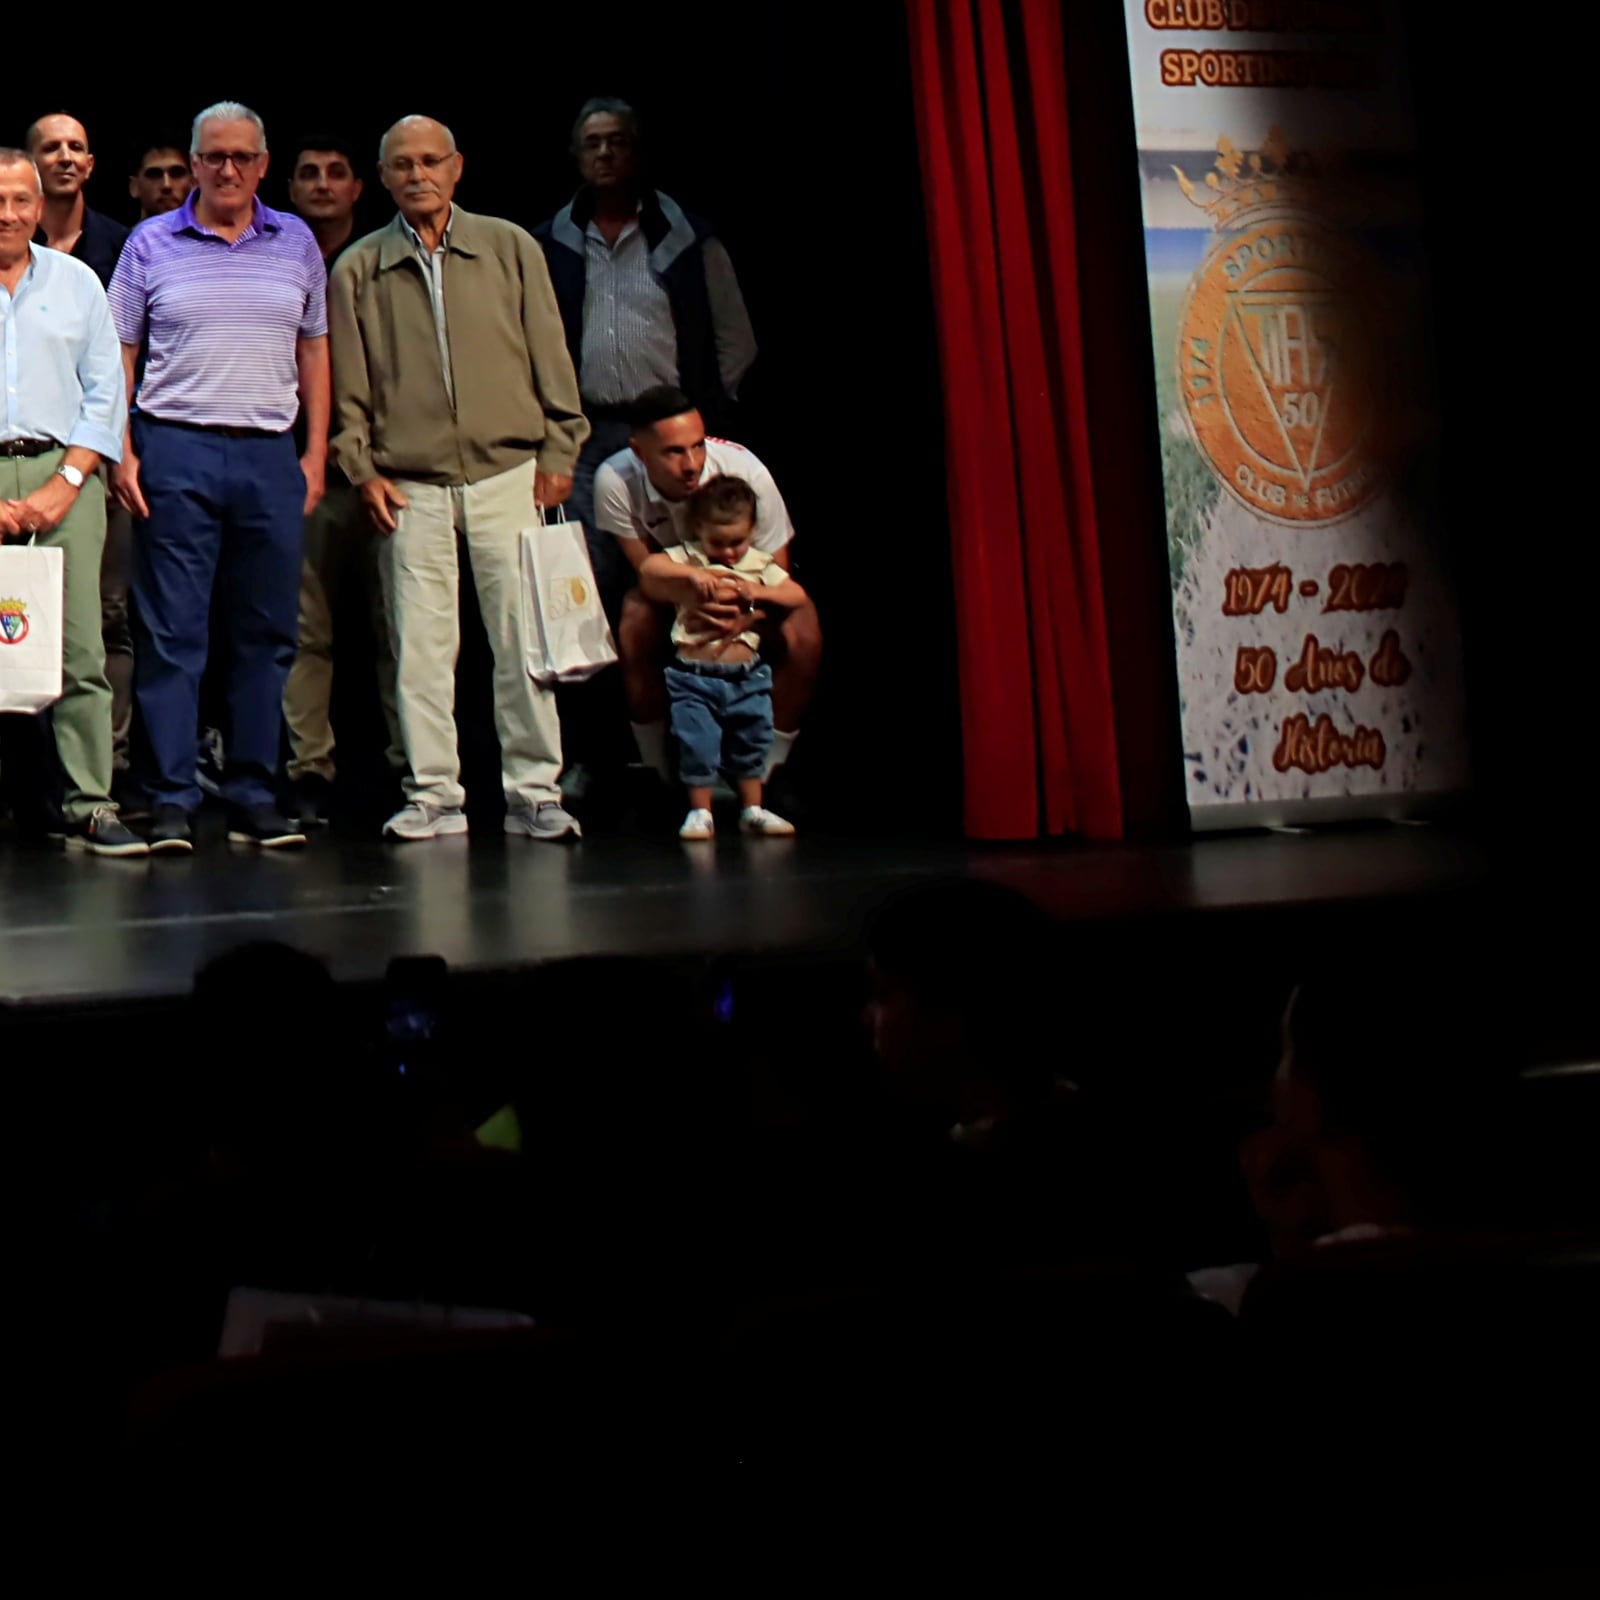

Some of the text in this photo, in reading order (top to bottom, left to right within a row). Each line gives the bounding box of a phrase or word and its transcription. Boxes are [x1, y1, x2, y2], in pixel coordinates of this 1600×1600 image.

[1282, 391, 1319, 428] 50
[1236, 463, 1286, 506] CLUB
[1237, 648, 1275, 692] 50
